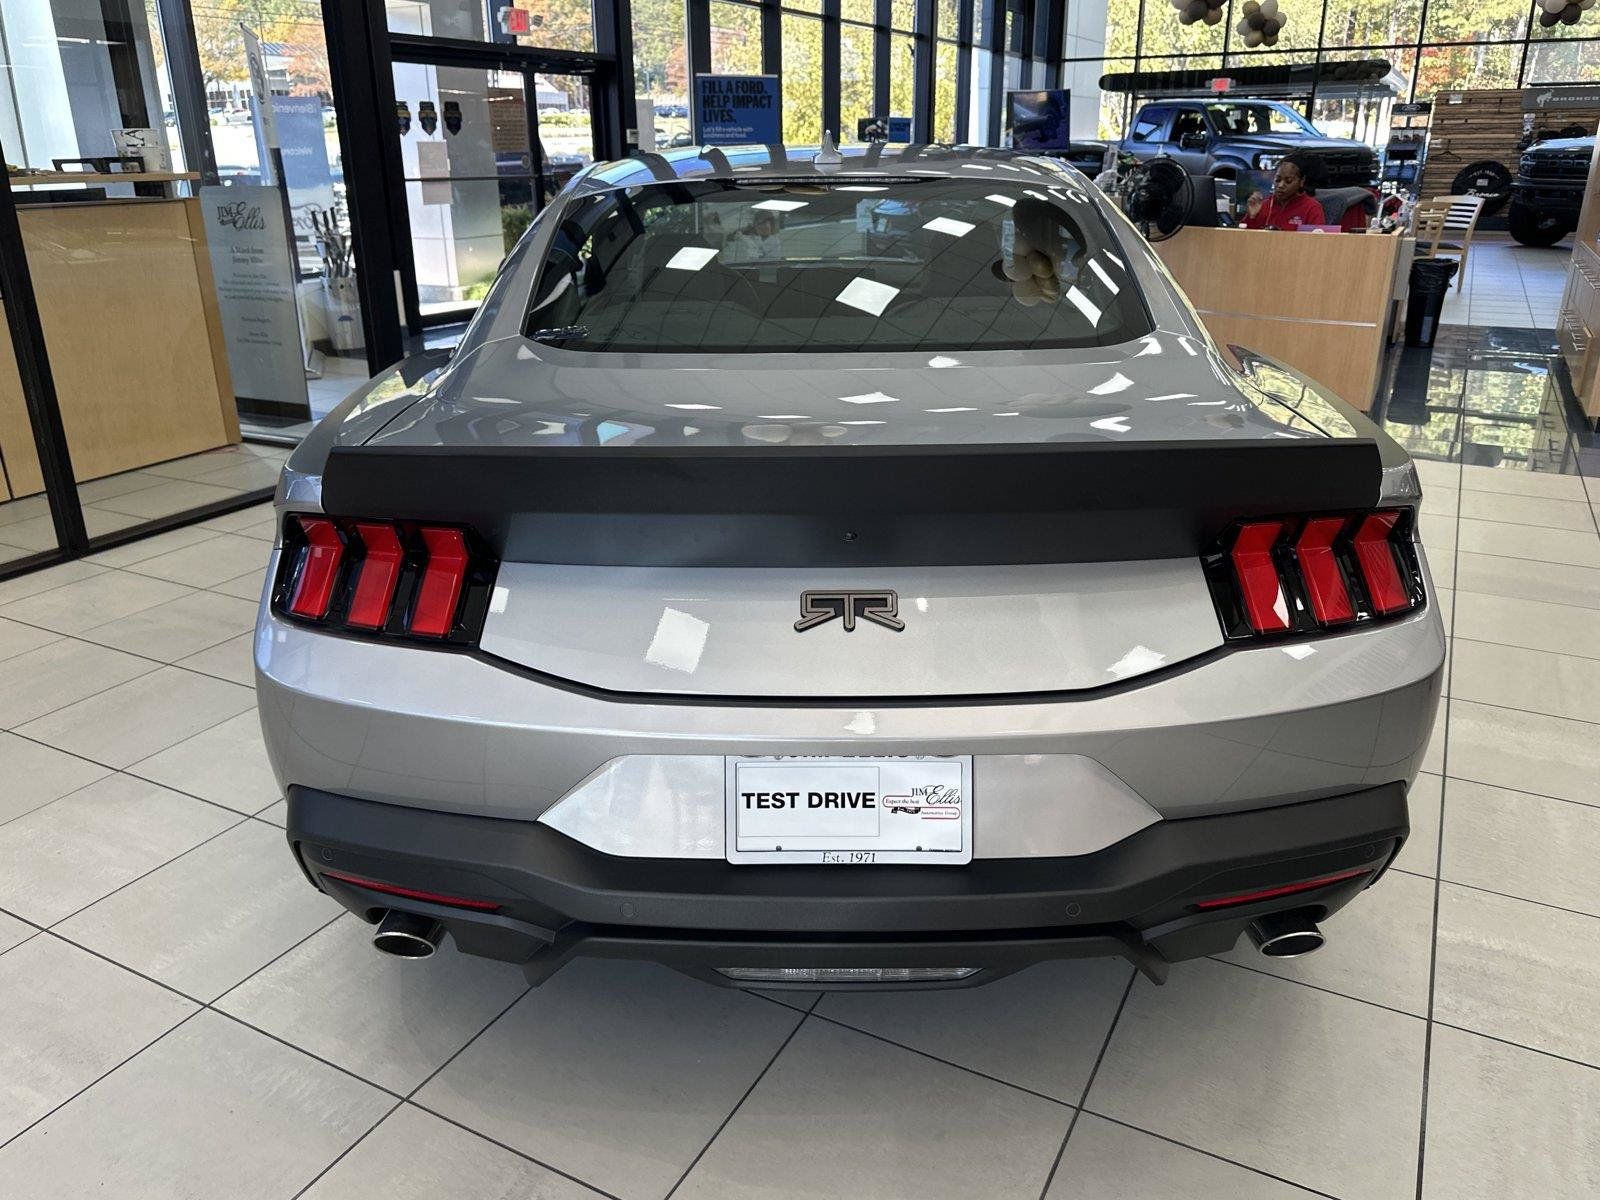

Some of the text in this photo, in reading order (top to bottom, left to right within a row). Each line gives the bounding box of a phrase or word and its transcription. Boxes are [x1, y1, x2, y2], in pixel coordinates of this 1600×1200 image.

[702, 81, 768, 95] FILL A FORD.
[702, 95, 772, 109] HELP IMPACT
[703, 110, 737, 123] LIVES.
[217, 201, 265, 232] JIM Ellis
[793, 589, 905, 633] RTR
[741, 792, 876, 809] TEST DRIVE
[911, 784, 961, 806] JIM Ellis
[822, 852, 876, 862] Est. 1971
